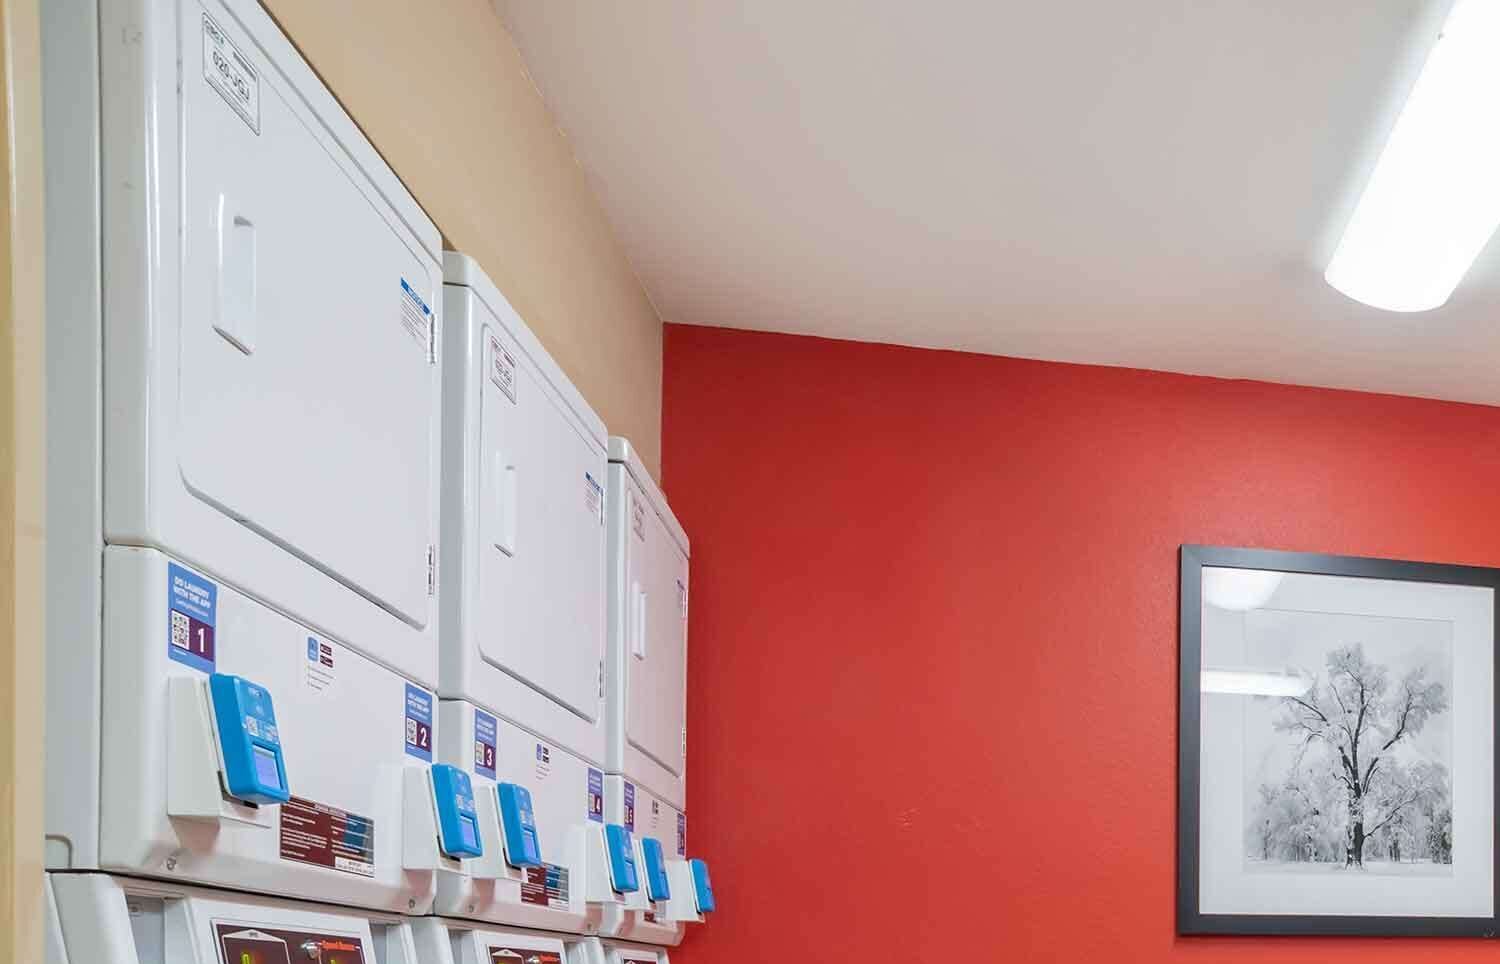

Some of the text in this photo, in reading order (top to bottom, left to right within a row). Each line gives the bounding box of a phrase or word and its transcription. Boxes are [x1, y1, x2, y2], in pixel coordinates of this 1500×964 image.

[198, 628, 205, 653] 1
[420, 727, 428, 747] 2
[486, 748, 493, 767] 3
